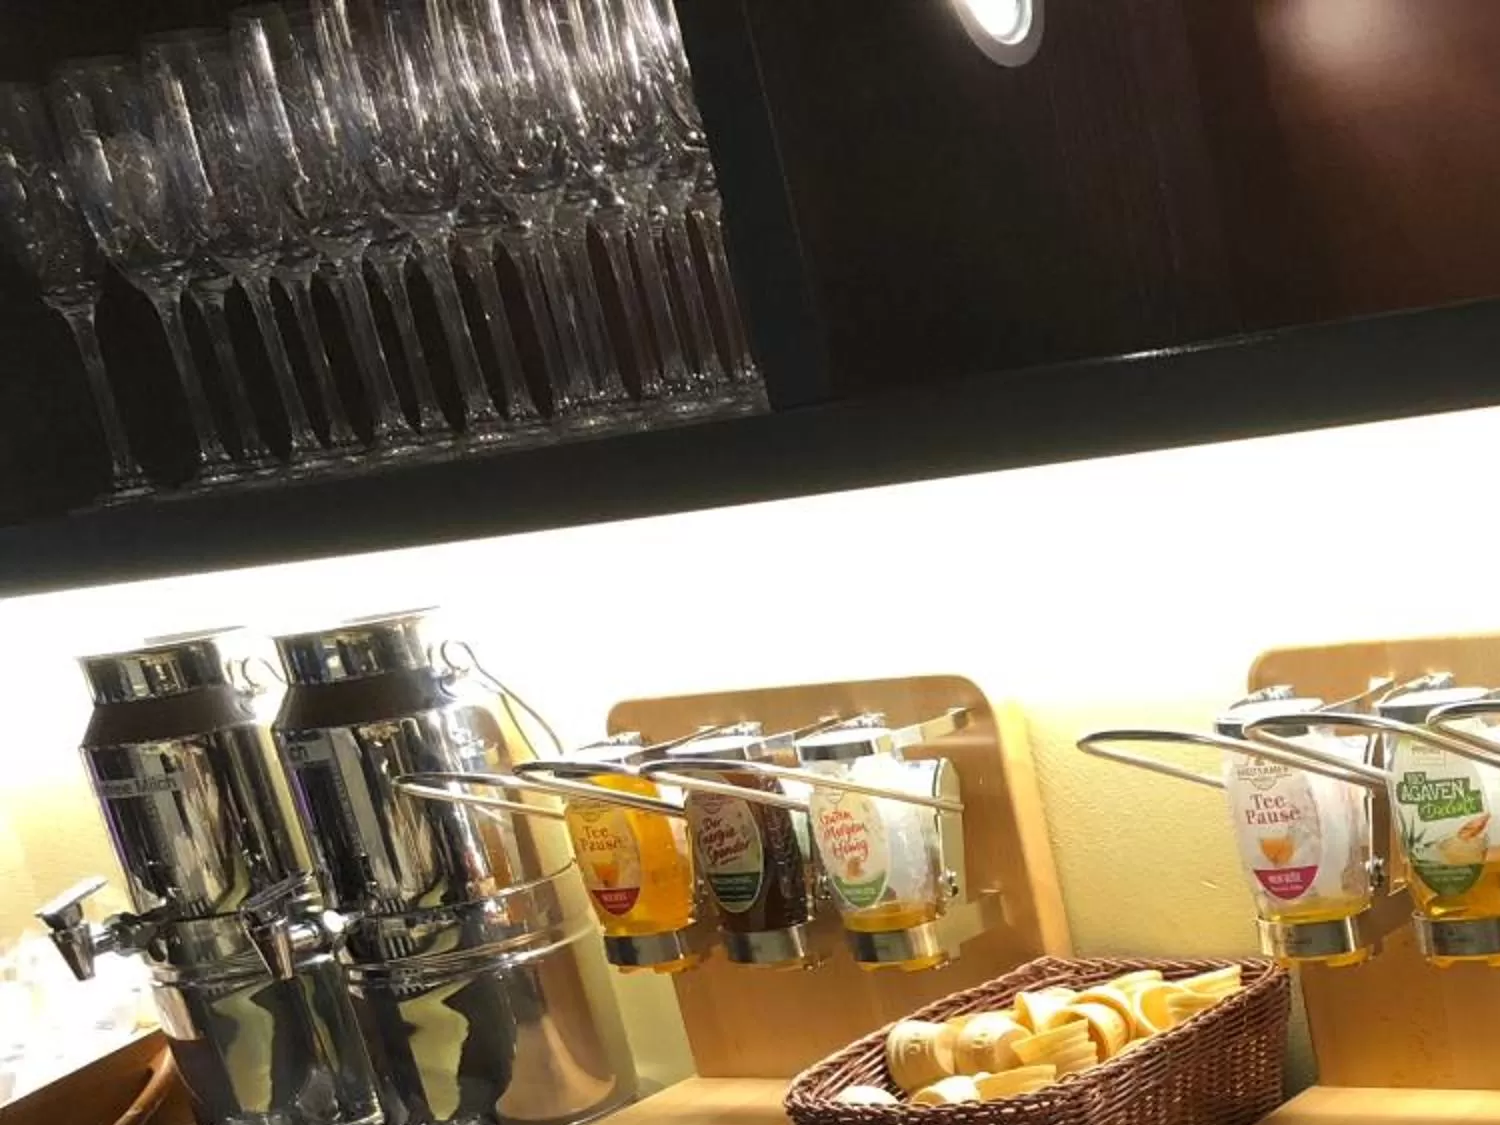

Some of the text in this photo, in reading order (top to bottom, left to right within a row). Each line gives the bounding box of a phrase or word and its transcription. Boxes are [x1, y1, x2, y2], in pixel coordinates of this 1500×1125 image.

[1401, 780, 1465, 802] AGAVEN
[1250, 794, 1285, 811] Tee
[1245, 807, 1301, 825] Pause
[582, 826, 609, 840] Tee
